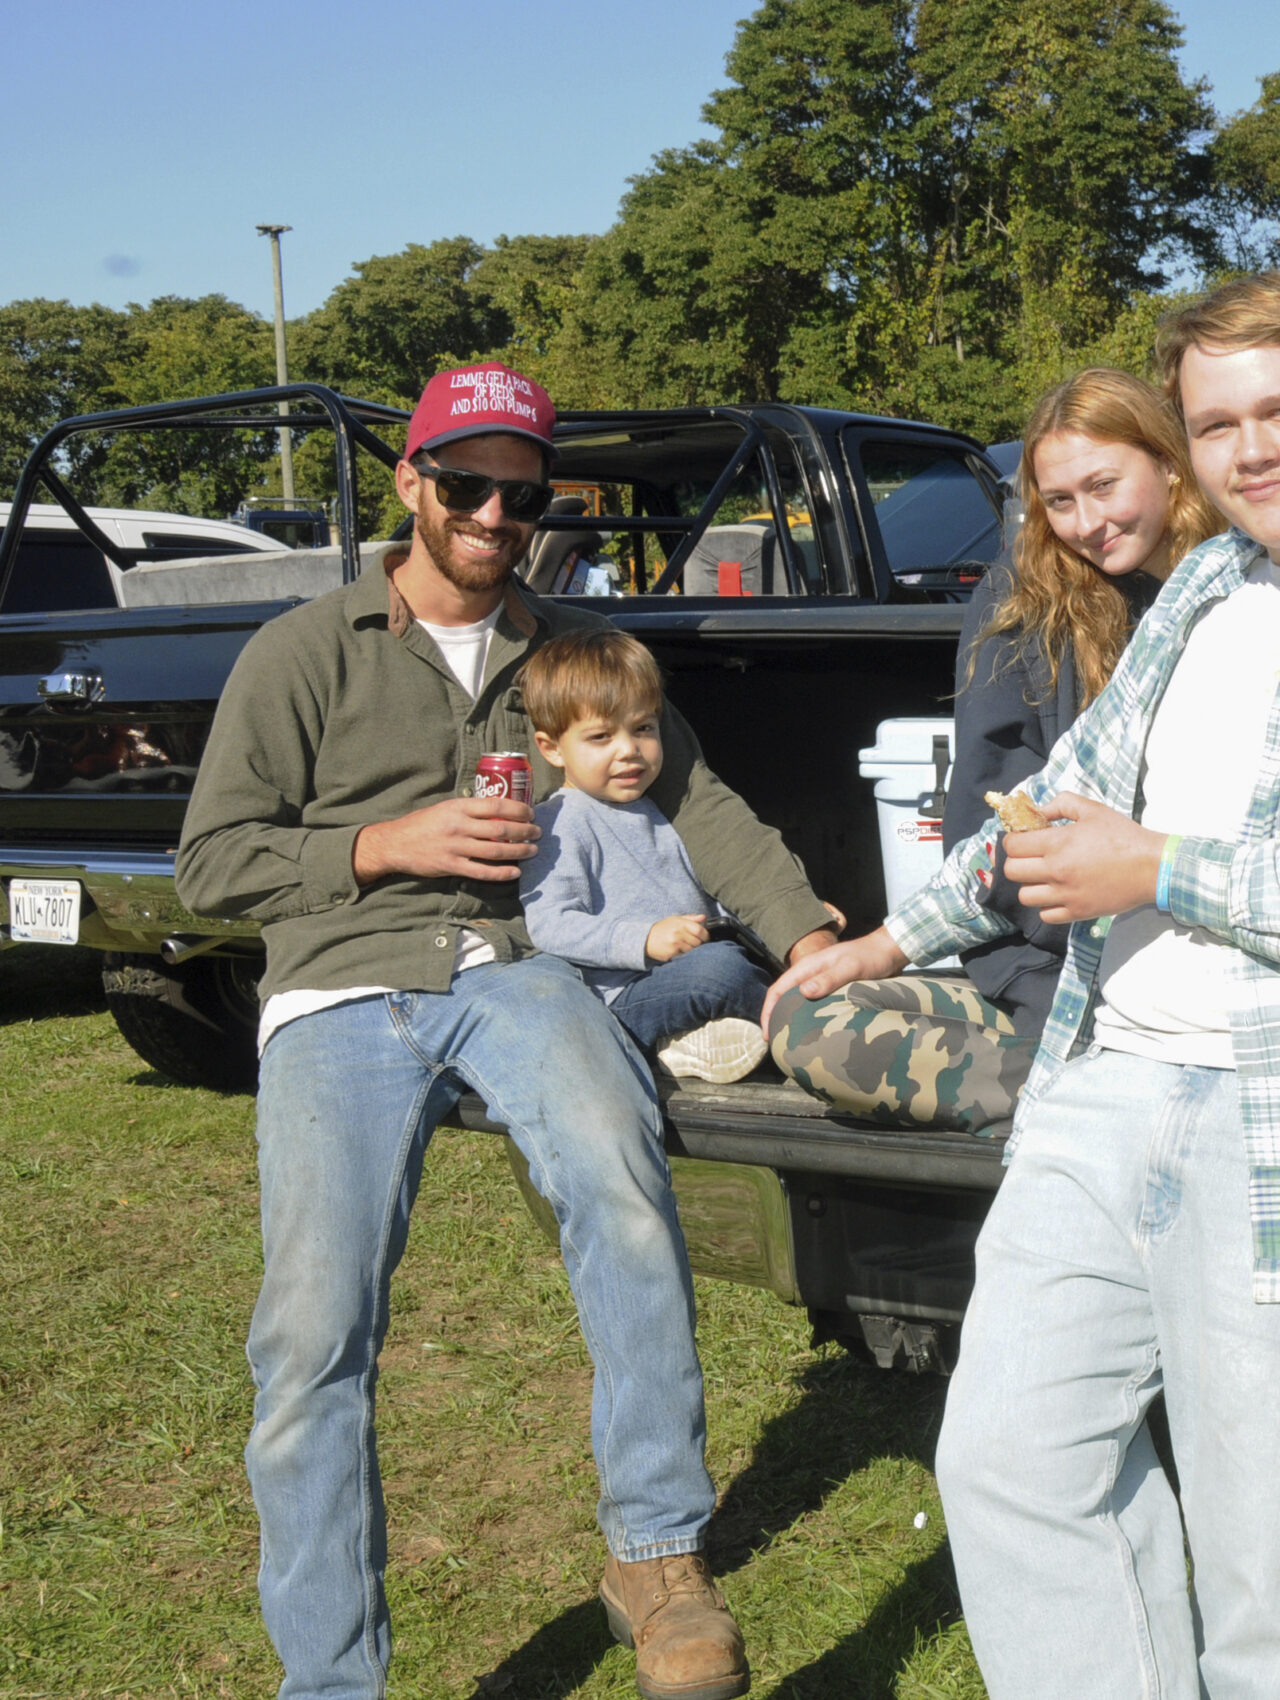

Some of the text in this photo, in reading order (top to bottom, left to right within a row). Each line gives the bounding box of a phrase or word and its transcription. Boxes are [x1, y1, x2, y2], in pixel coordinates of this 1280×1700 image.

[450, 370, 533, 396] LEMME GET A PACK
[474, 383, 515, 401] OF REDS
[450, 397, 537, 423] AND $10 ON PUMP 6
[476, 774, 490, 790] Dr
[28, 885, 63, 896] NEW YORK
[14, 896, 73, 928] KLU 7807
